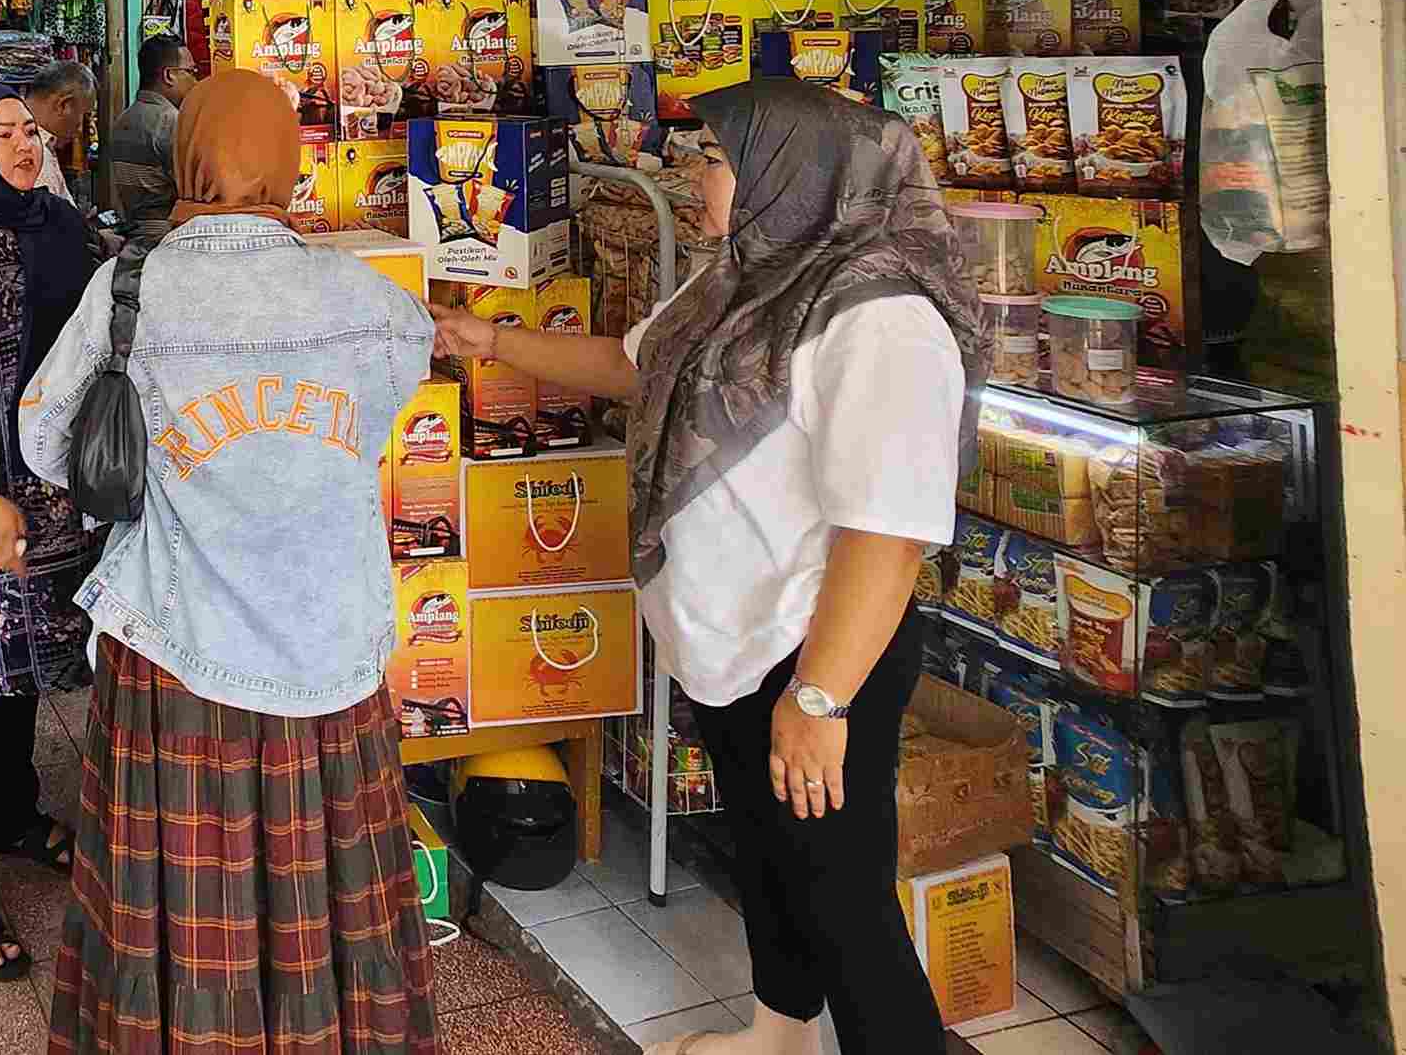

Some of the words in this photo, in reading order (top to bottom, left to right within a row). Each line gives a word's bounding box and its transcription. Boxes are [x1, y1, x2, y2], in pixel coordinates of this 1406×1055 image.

[252, 41, 322, 58] Amplang
[354, 37, 424, 55] Amplang
[451, 35, 517, 53] Amplang
[898, 81, 941, 102] Cris
[354, 189, 410, 208] Ampla
[1044, 252, 1160, 287] Amplang
[409, 610, 460, 626] Amplang
